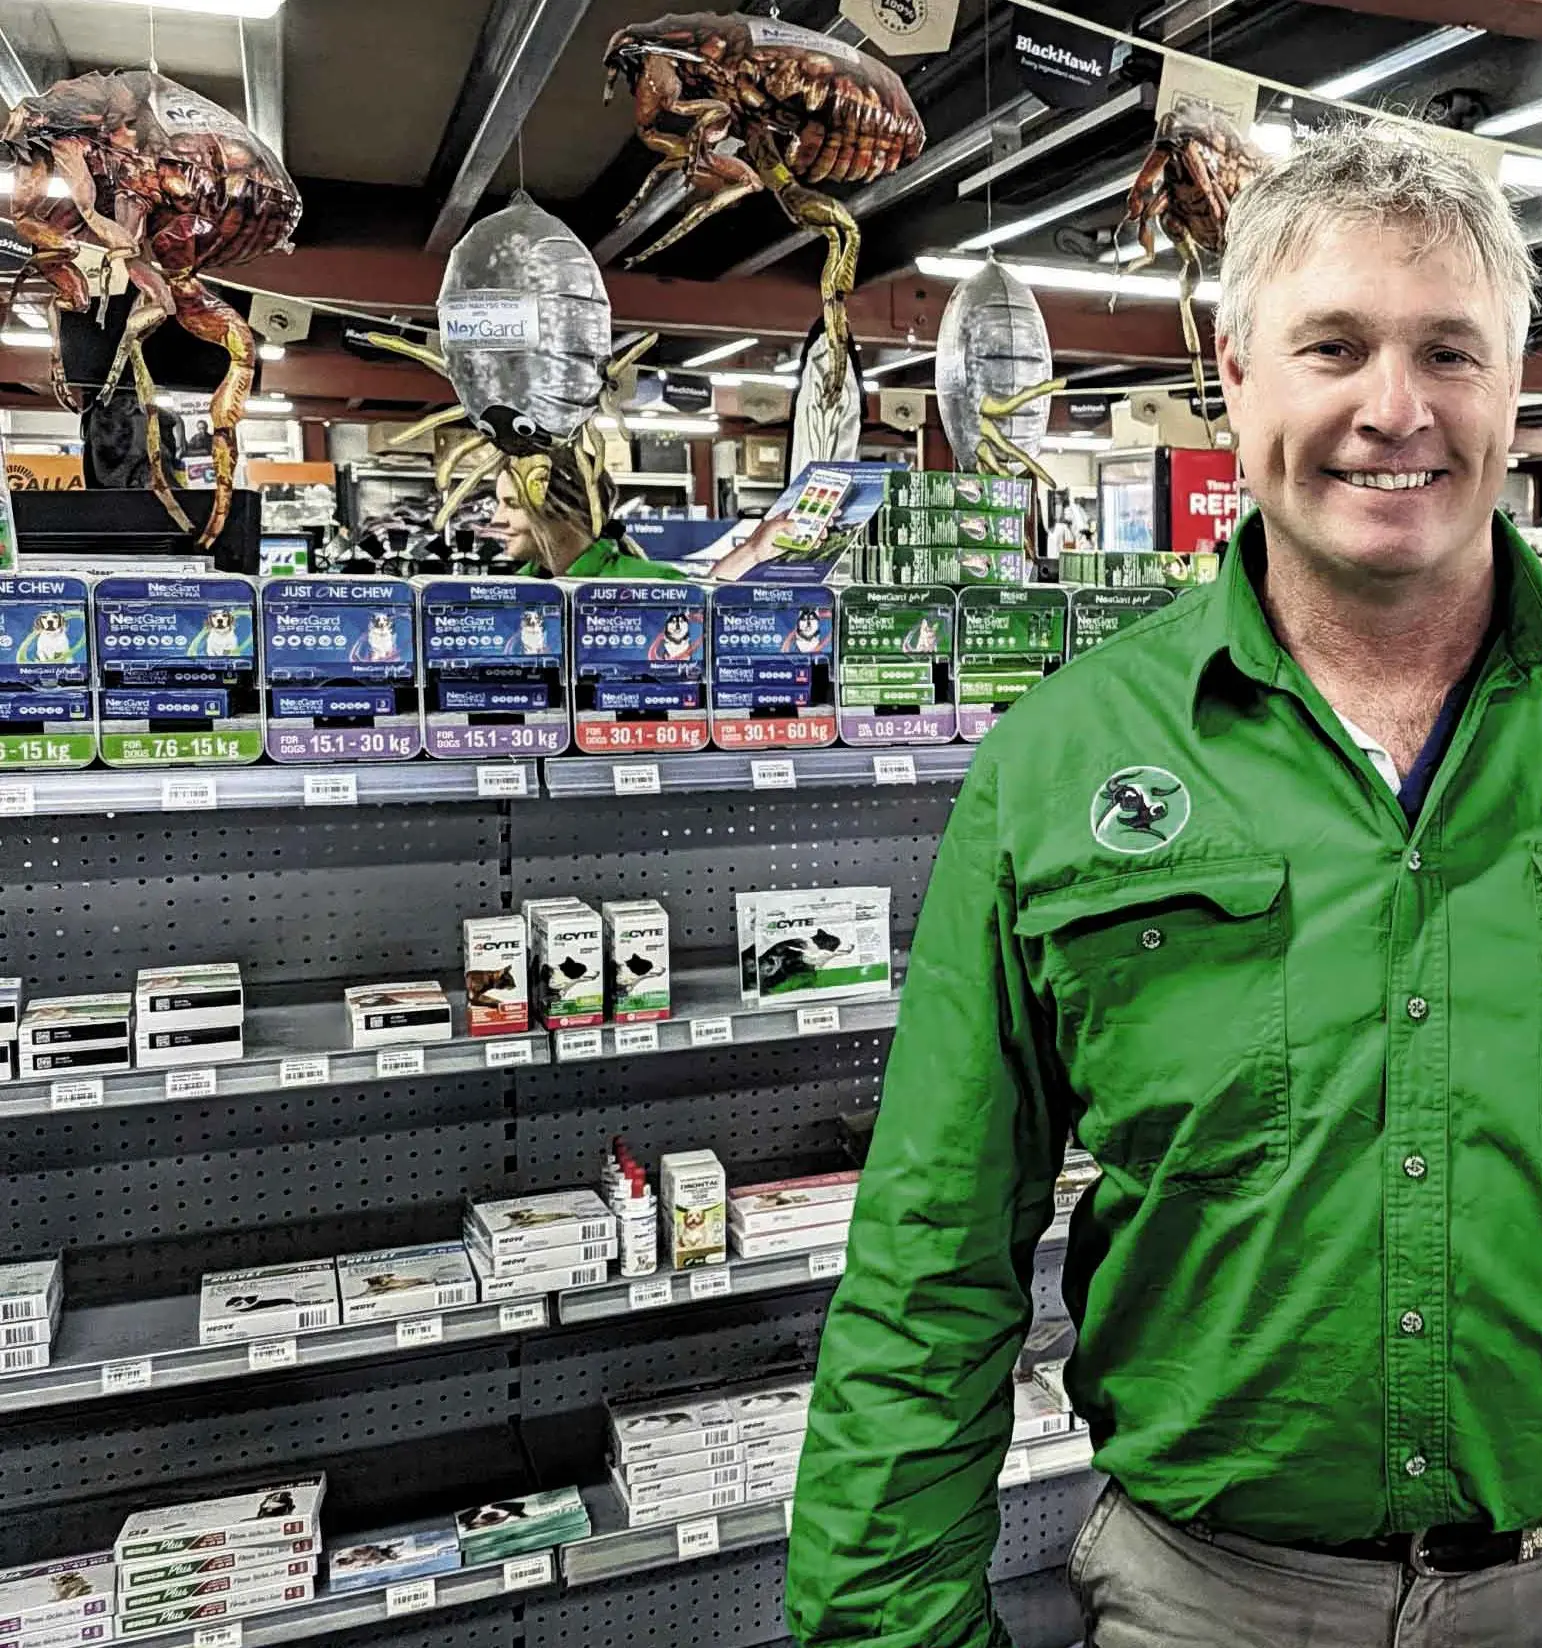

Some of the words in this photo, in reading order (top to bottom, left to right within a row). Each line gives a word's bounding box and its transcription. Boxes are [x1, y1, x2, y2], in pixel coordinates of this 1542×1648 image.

[1016, 35, 1102, 77] BlackHawk
[18, 582, 64, 593] CHEW
[148, 583, 200, 593] NexGard
[281, 586, 312, 598] JUST
[316, 586, 349, 598] ONE
[351, 587, 393, 598] CHEW
[470, 587, 517, 596] NexGard
[591, 590, 617, 599] JUST
[620, 589, 648, 599] ONE
[651, 590, 687, 599] CHEW
[867, 593, 906, 601] NexGard
[110, 613, 176, 625] NexGard
[277, 615, 340, 626] NexGard
[435, 616, 495, 627] NexGard
[586, 617, 642, 625] NexGard
[723, 616, 775, 626] NexGard
[602, 693, 639, 701] NexGard
[105, 699, 150, 707] NexGard
[280, 699, 323, 707] NexGard
[744, 725, 774, 740] 30.1
[788, 724, 807, 739] 60
[811, 724, 828, 740] kg
[876, 721, 894, 735] 0.8
[904, 721, 922, 735] 2.4
[923, 721, 938, 736] kg
[281, 736, 298, 745] FOR
[437, 731, 454, 740] FOR
[465, 731, 496, 748] 15.1
[512, 730, 533, 747] 30
[538, 730, 558, 748] kg
[611, 727, 643, 744] 30.1
[656, 727, 676, 742] 60
[682, 727, 700, 745] kg
[123, 740, 141, 749] FOR
[154, 740, 177, 757] 7.6
[192, 740, 212, 756] 15
[216, 739, 239, 757] kg
[310, 736, 344, 753] 15.1
[360, 735, 384, 752] 30
[390, 735, 410, 754] kg
[437, 740, 461, 748] DOGS
[18, 741, 43, 760] 15
[47, 742, 71, 762] kg
[281, 745, 305, 754] DOGS
[767, 918, 815, 928] 4CYTE
[554, 931, 599, 941] 4CYTE
[620, 929, 663, 938] 4CYTE
[474, 941, 520, 951] 4CYTE
[160, 1538, 185, 1551] Plus
[168, 1562, 194, 1576] Plus
[164, 1585, 189, 1600] Plus
[160, 1610, 184, 1624] Plus
